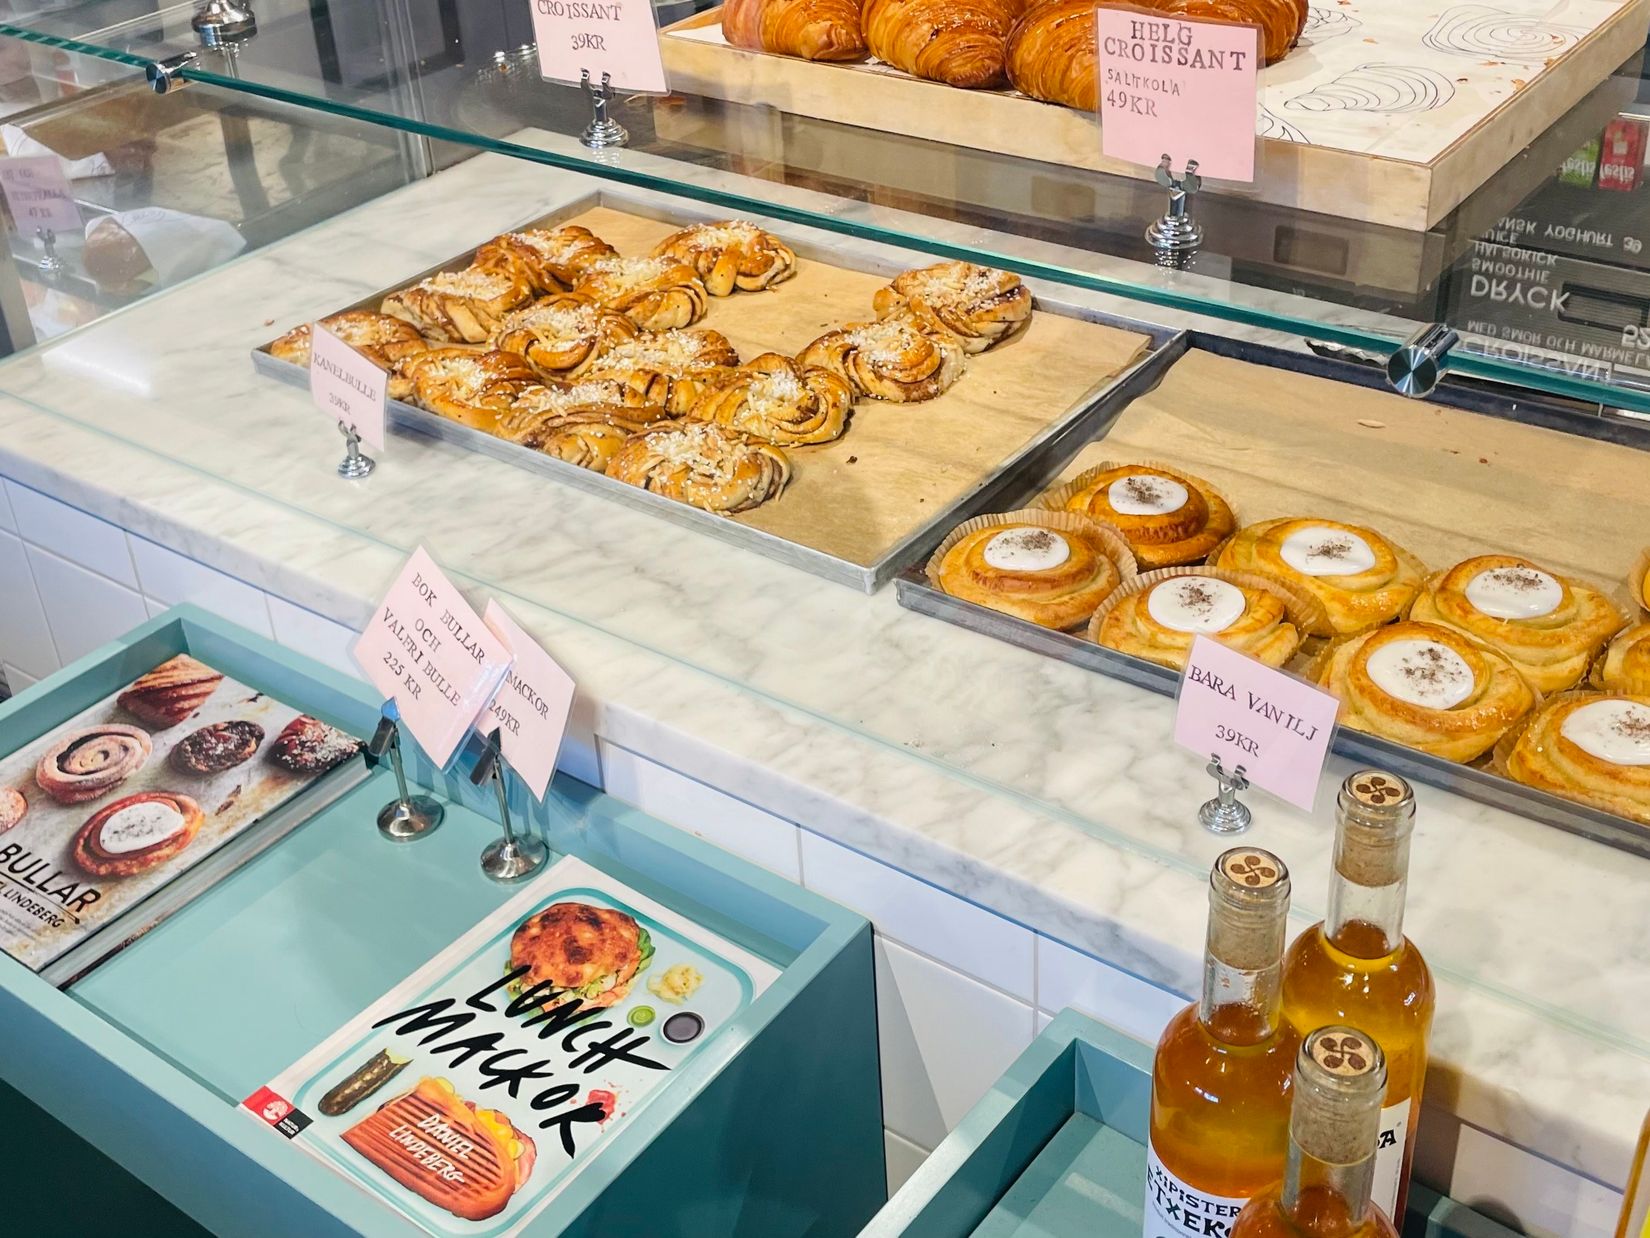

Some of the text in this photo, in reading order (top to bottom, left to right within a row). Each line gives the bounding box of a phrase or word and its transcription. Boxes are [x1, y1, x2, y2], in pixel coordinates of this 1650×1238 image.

[537, 0, 622, 21] CROISSANT
[1130, 20, 1193, 48] HELG
[570, 32, 607, 51] 39KR
[1104, 36, 1246, 71] CROISSANT
[1106, 89, 1158, 118] 49KR
[313, 352, 377, 402] KANELBULLE
[412, 572, 486, 665] BOK BULLAR
[414, 618, 442, 652] OCH
[383, 607, 461, 707] VALFRI BULLE
[383, 651, 423, 700] 225 KR
[488, 698, 521, 737] 249KR
[1188, 664, 1319, 742] BARA VANILJ
[1215, 724, 1260, 758] 39KR
[0, 842, 102, 913] BULLAR
[3, 888, 65, 928] LINDEBERG
[465, 965, 672, 1073] LUNCH
[371, 998, 606, 1160] MACKOR
[388, 1124, 465, 1183] LINDEBERG
[416, 1113, 474, 1160] DANIEL
